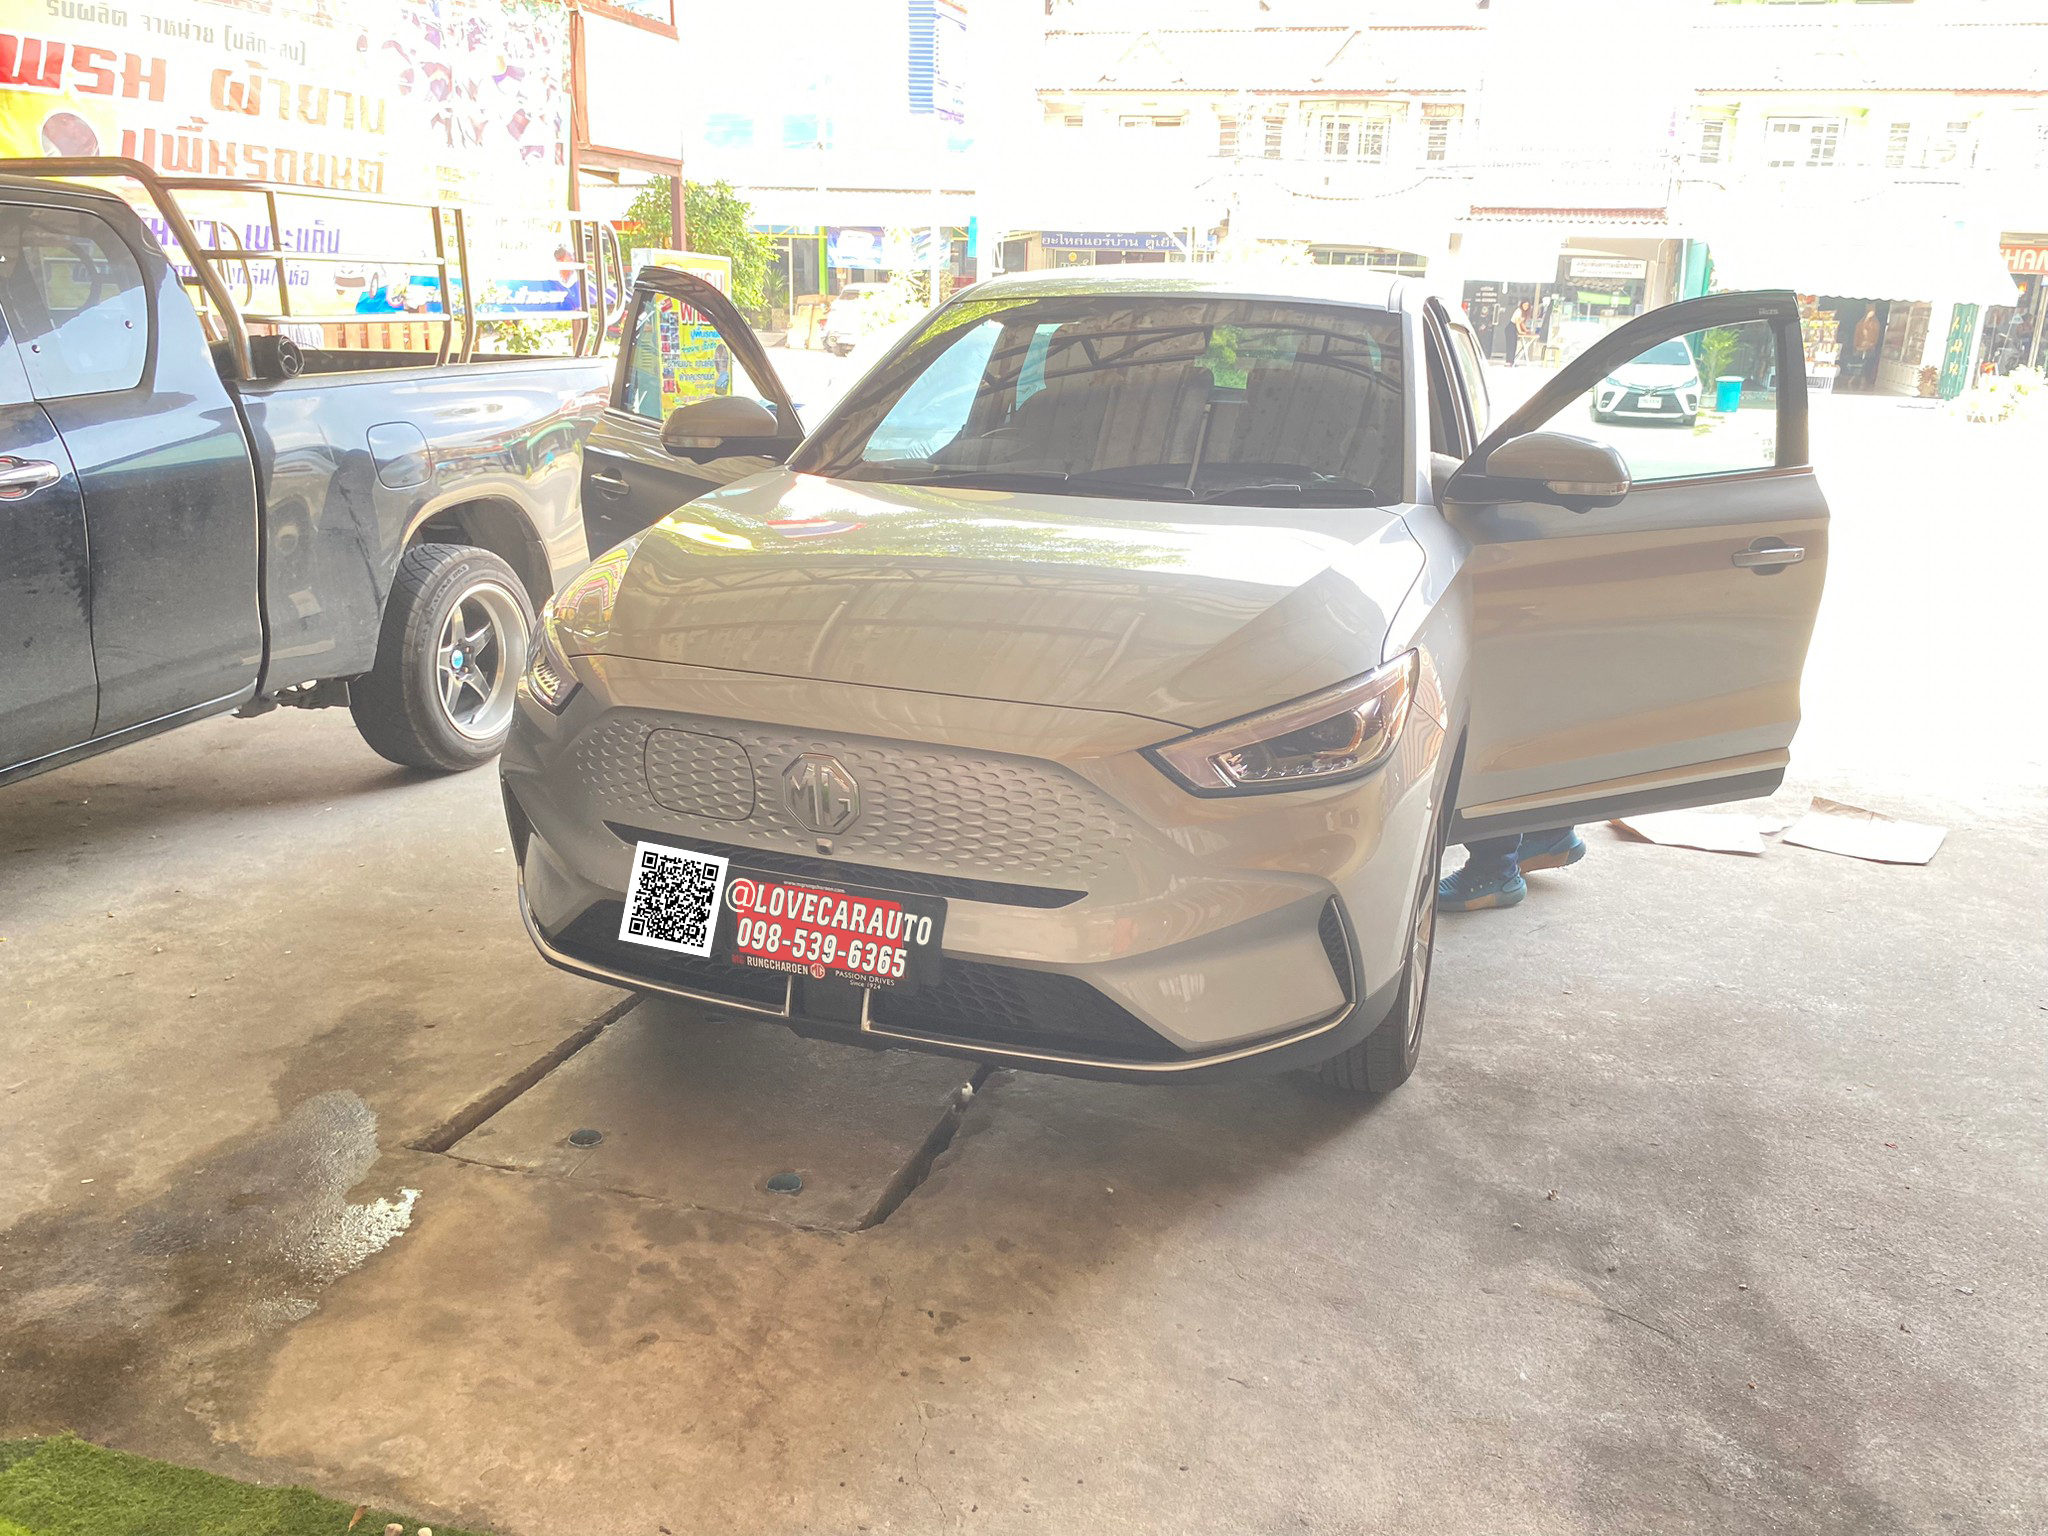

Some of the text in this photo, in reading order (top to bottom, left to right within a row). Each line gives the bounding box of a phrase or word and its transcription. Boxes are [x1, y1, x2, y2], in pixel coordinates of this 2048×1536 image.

[46, 0, 128, 28] รบผลิต
[121, 116, 390, 195] ปพื้นรถยนต์
[791, 762, 851, 828] MG
[746, 955, 809, 976] RUNGCHAROEN
[834, 969, 896, 987] PASSION DRIVES
[849, 979, 881, 990] Since 1924
